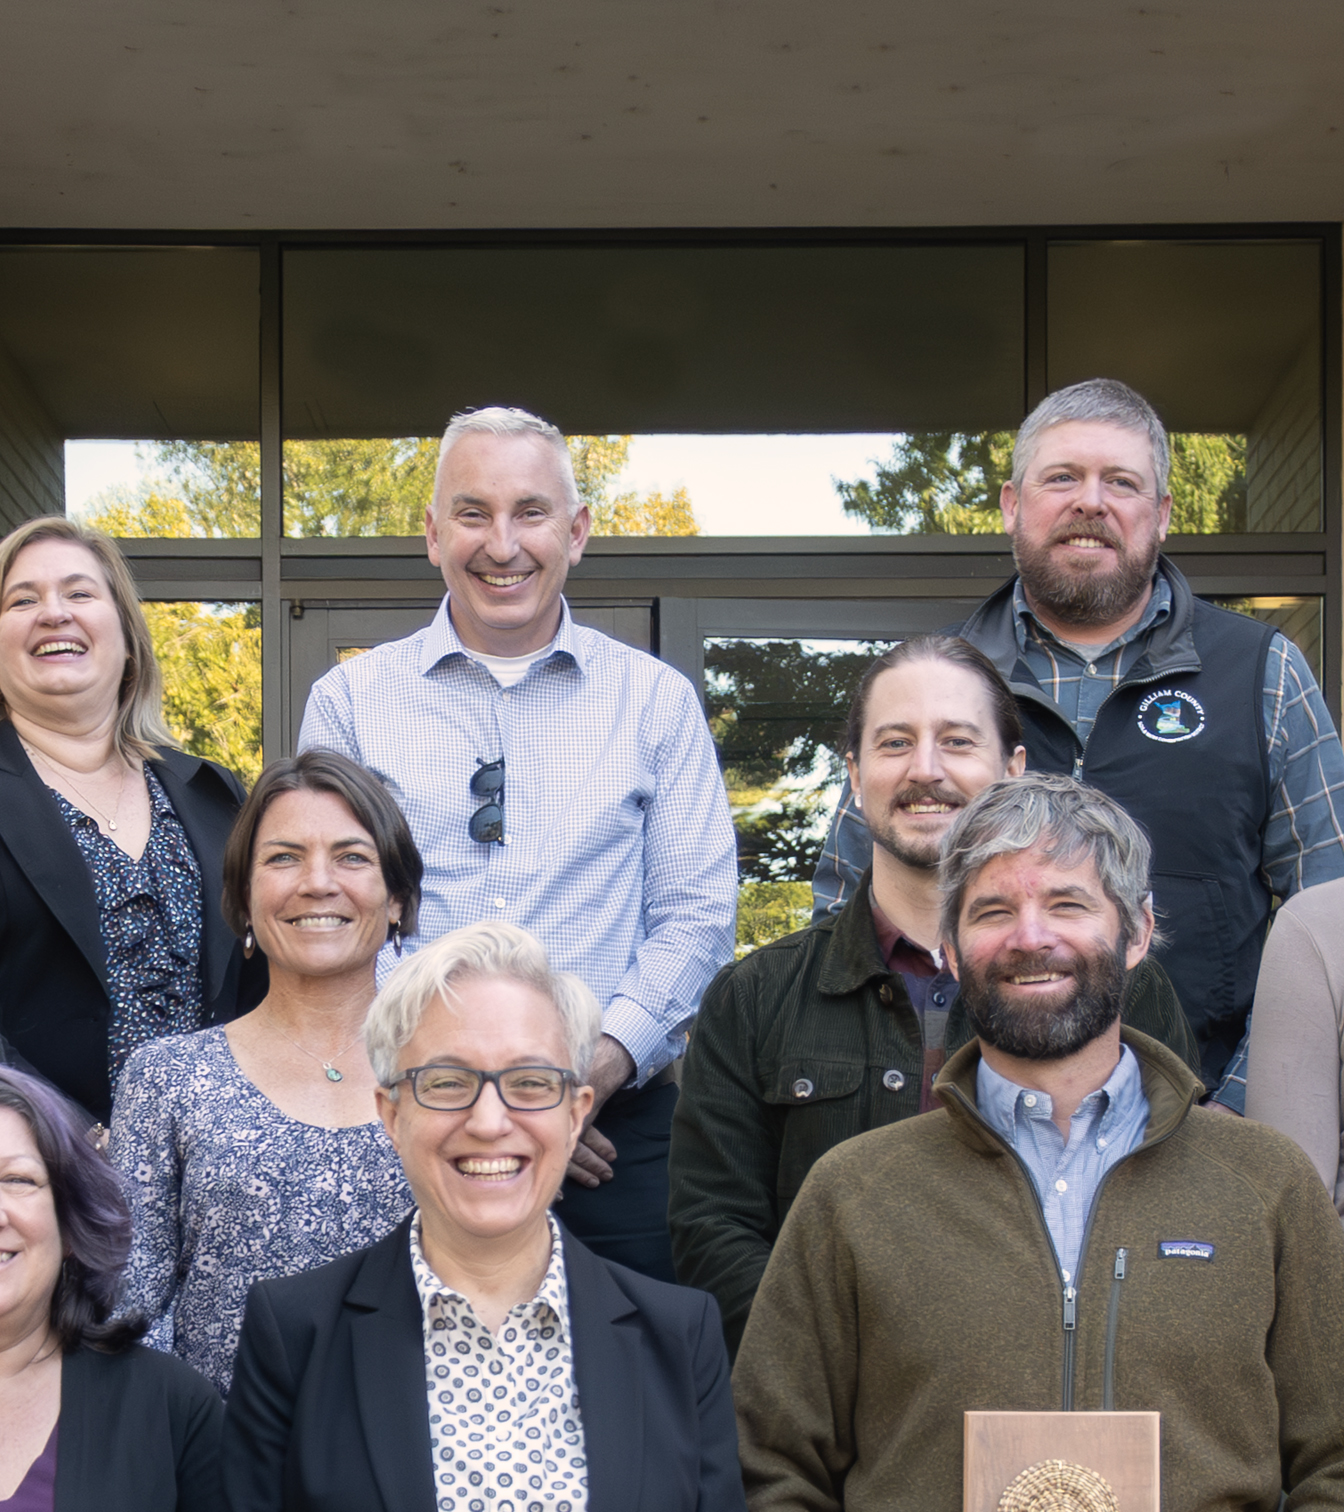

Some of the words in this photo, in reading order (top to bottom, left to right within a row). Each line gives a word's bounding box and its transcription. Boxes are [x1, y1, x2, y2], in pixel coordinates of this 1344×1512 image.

[1139, 690, 1172, 712] GILLIAM
[1174, 690, 1204, 715] COUNTY
[1165, 1248, 1209, 1258] patagonia
